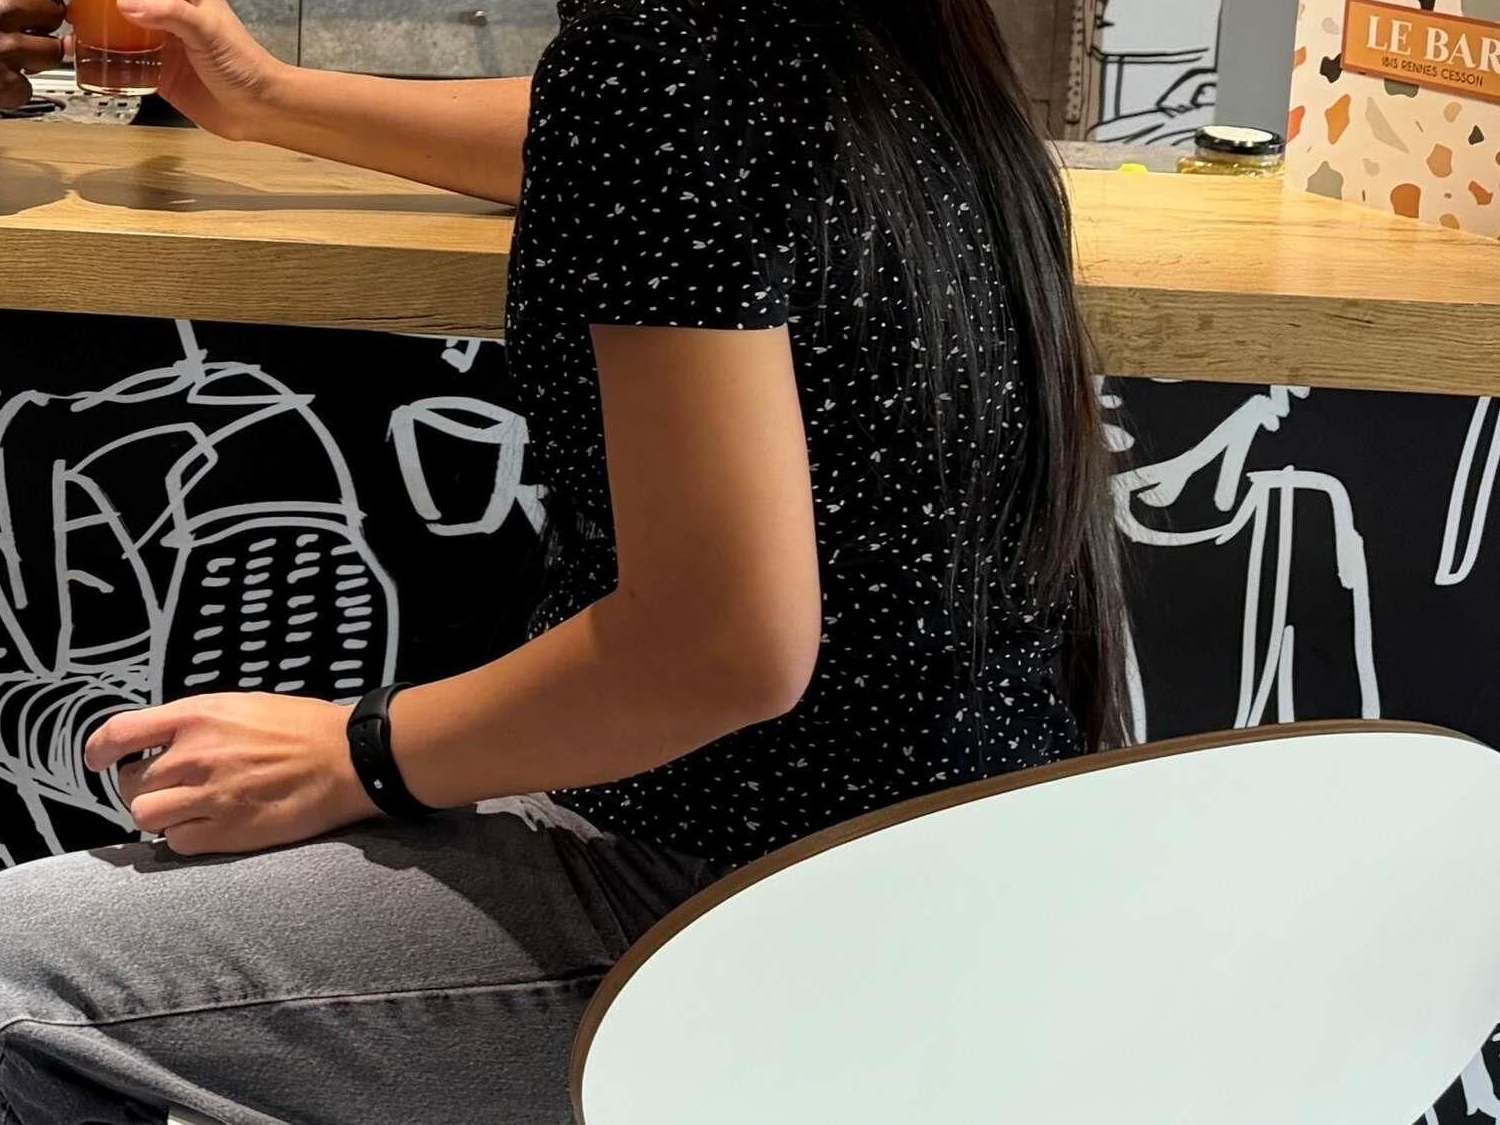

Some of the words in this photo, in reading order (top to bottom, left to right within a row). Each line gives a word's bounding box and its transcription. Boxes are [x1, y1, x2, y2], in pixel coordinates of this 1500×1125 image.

[1366, 15, 1412, 55] LE
[1424, 26, 1500, 75] BAR
[1382, 55, 1399, 69] IBIS
[1401, 60, 1438, 77] RENNES
[1441, 68, 1484, 87] CESSON
